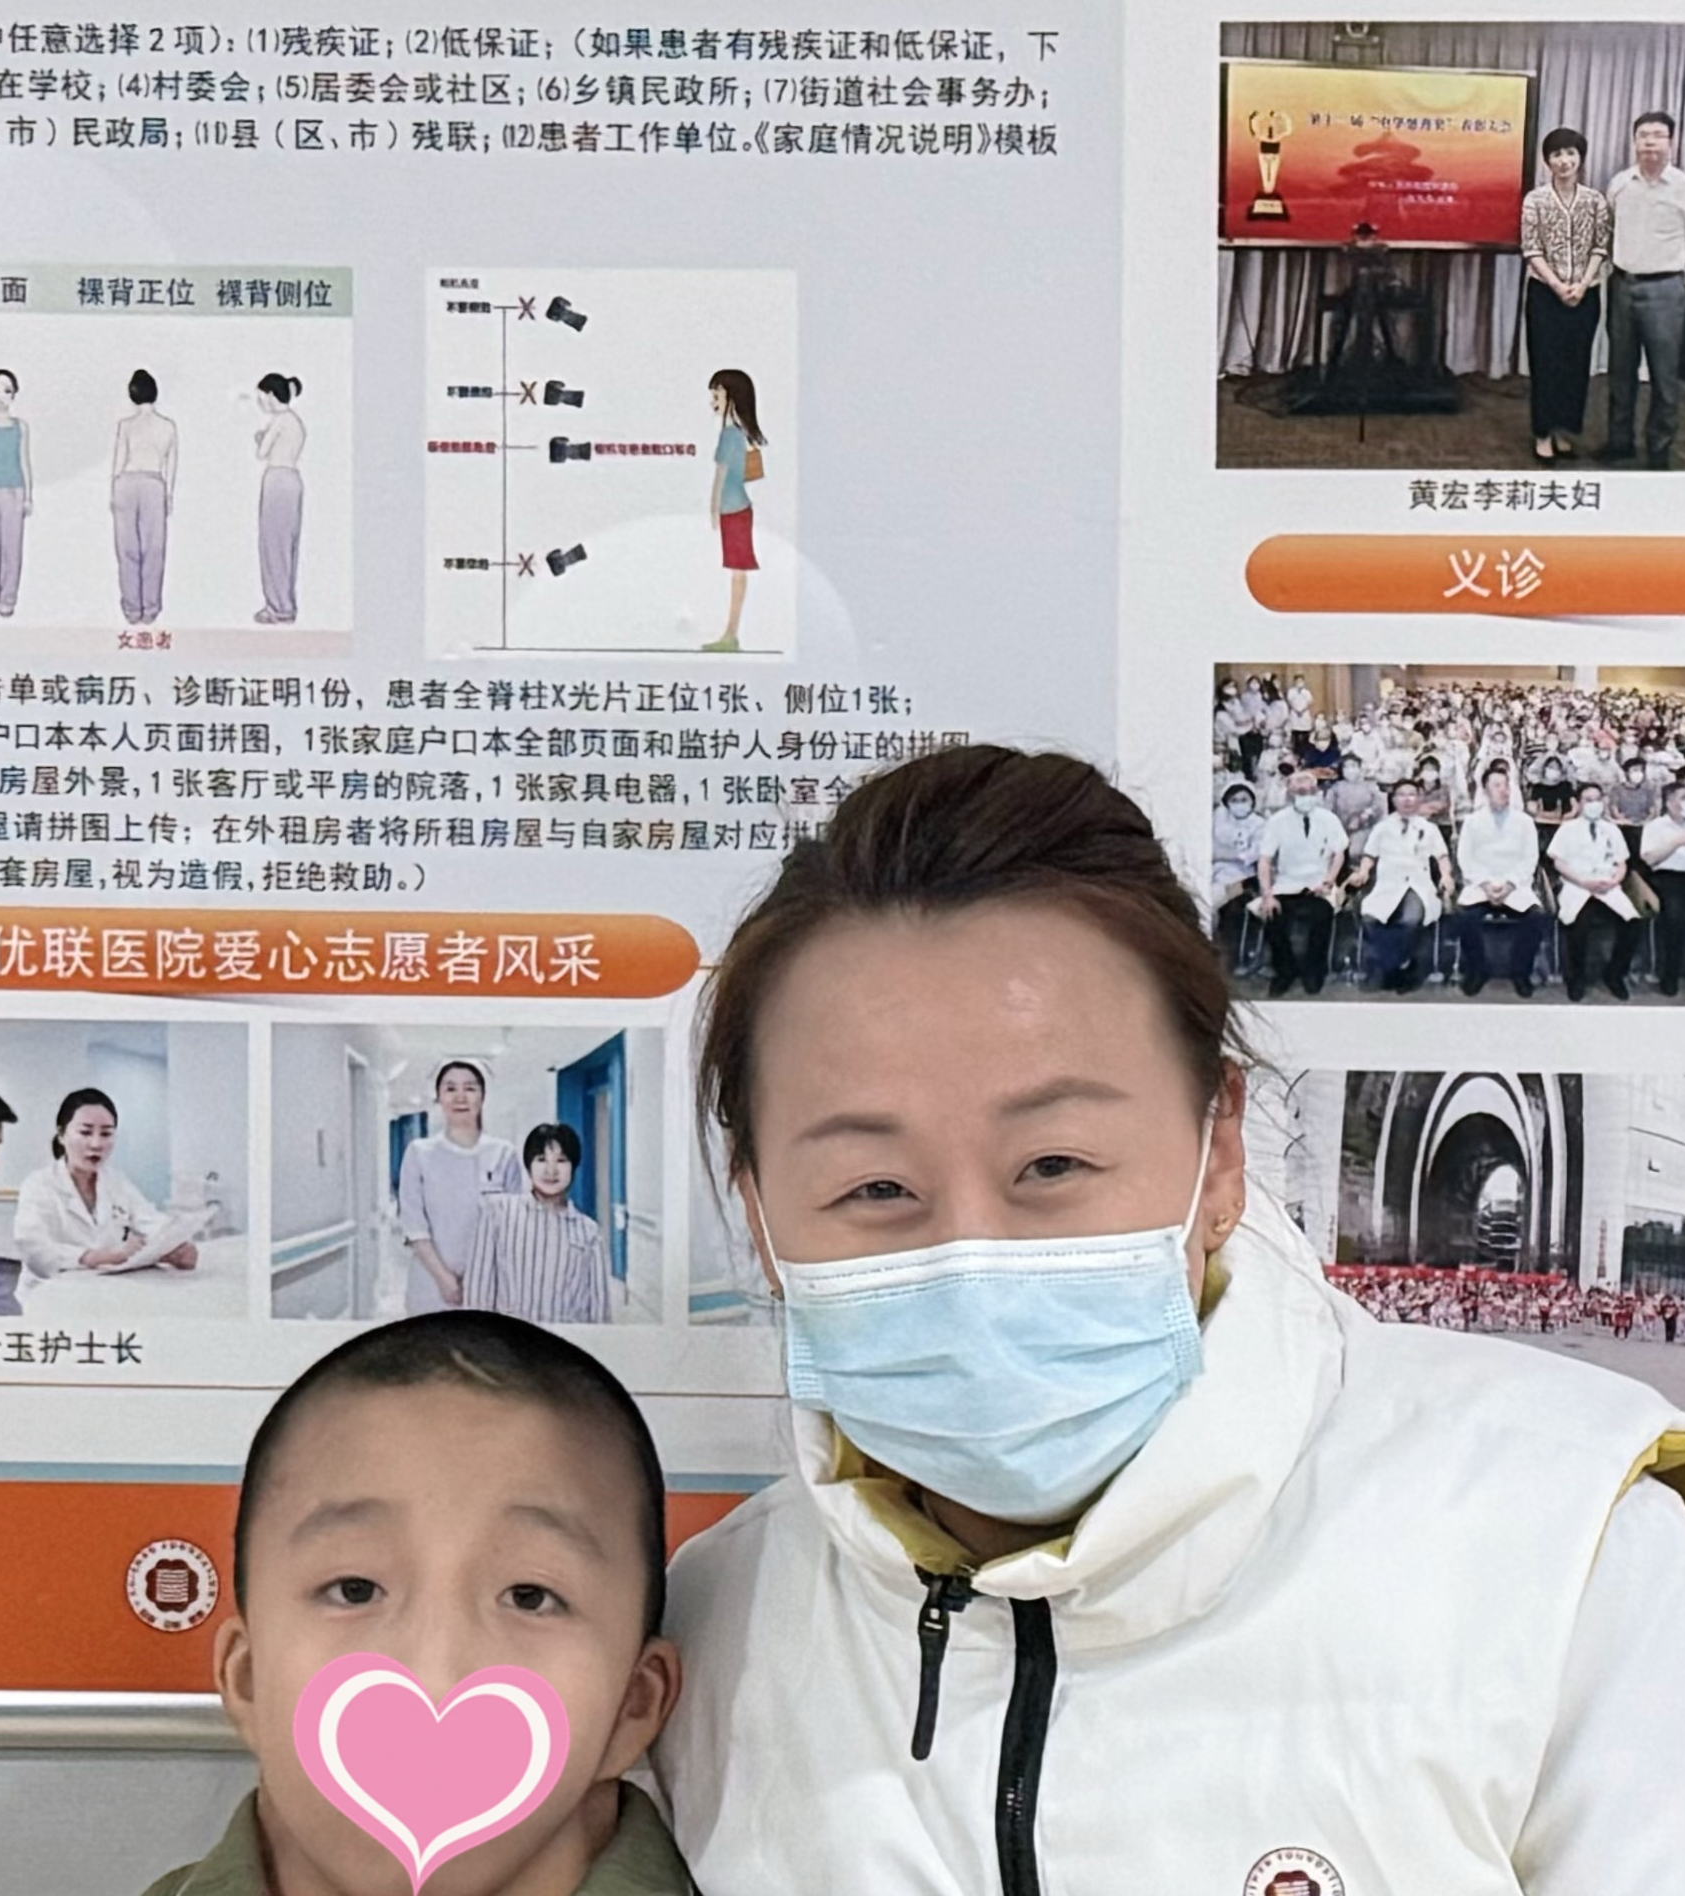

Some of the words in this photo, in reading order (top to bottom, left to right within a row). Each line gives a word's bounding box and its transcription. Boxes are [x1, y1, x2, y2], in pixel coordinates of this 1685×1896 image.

[77, 278, 195, 308] 裸背正位
[216, 281, 334, 310] 裸背侧位
[1408, 480, 1601, 511] 黄宏李莉夫妇
[1443, 548, 1546, 600] 义诊
[117, 631, 172, 650] 女患者
